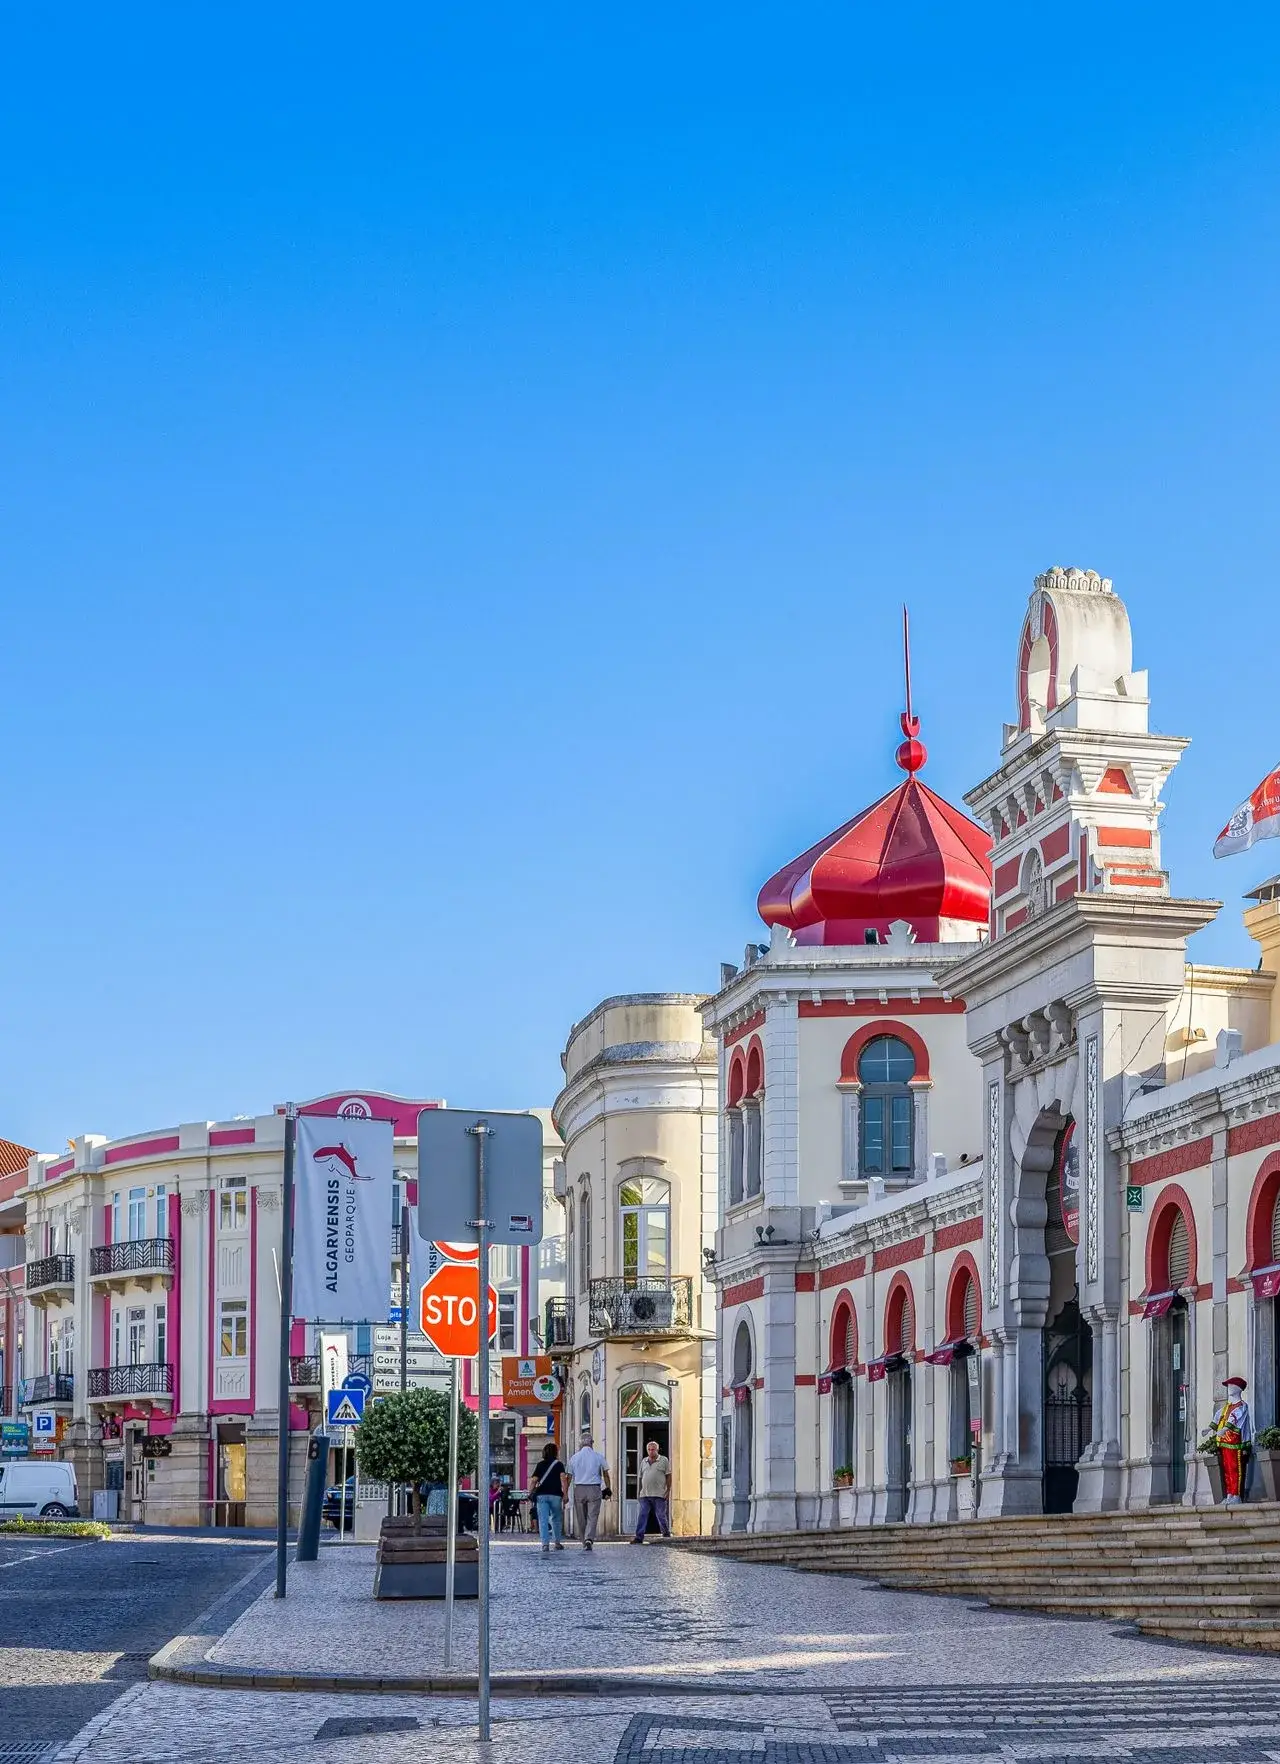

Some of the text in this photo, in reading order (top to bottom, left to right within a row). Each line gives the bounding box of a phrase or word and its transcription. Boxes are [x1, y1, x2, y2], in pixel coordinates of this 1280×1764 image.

[344, 1189, 356, 1263] GEOPARQUE
[325, 1179, 340, 1293] ALGARVENSIS
[376, 1356, 417, 1365] Correos
[376, 1379, 417, 1388] Mercdo
[39, 1417, 49, 1430] P
